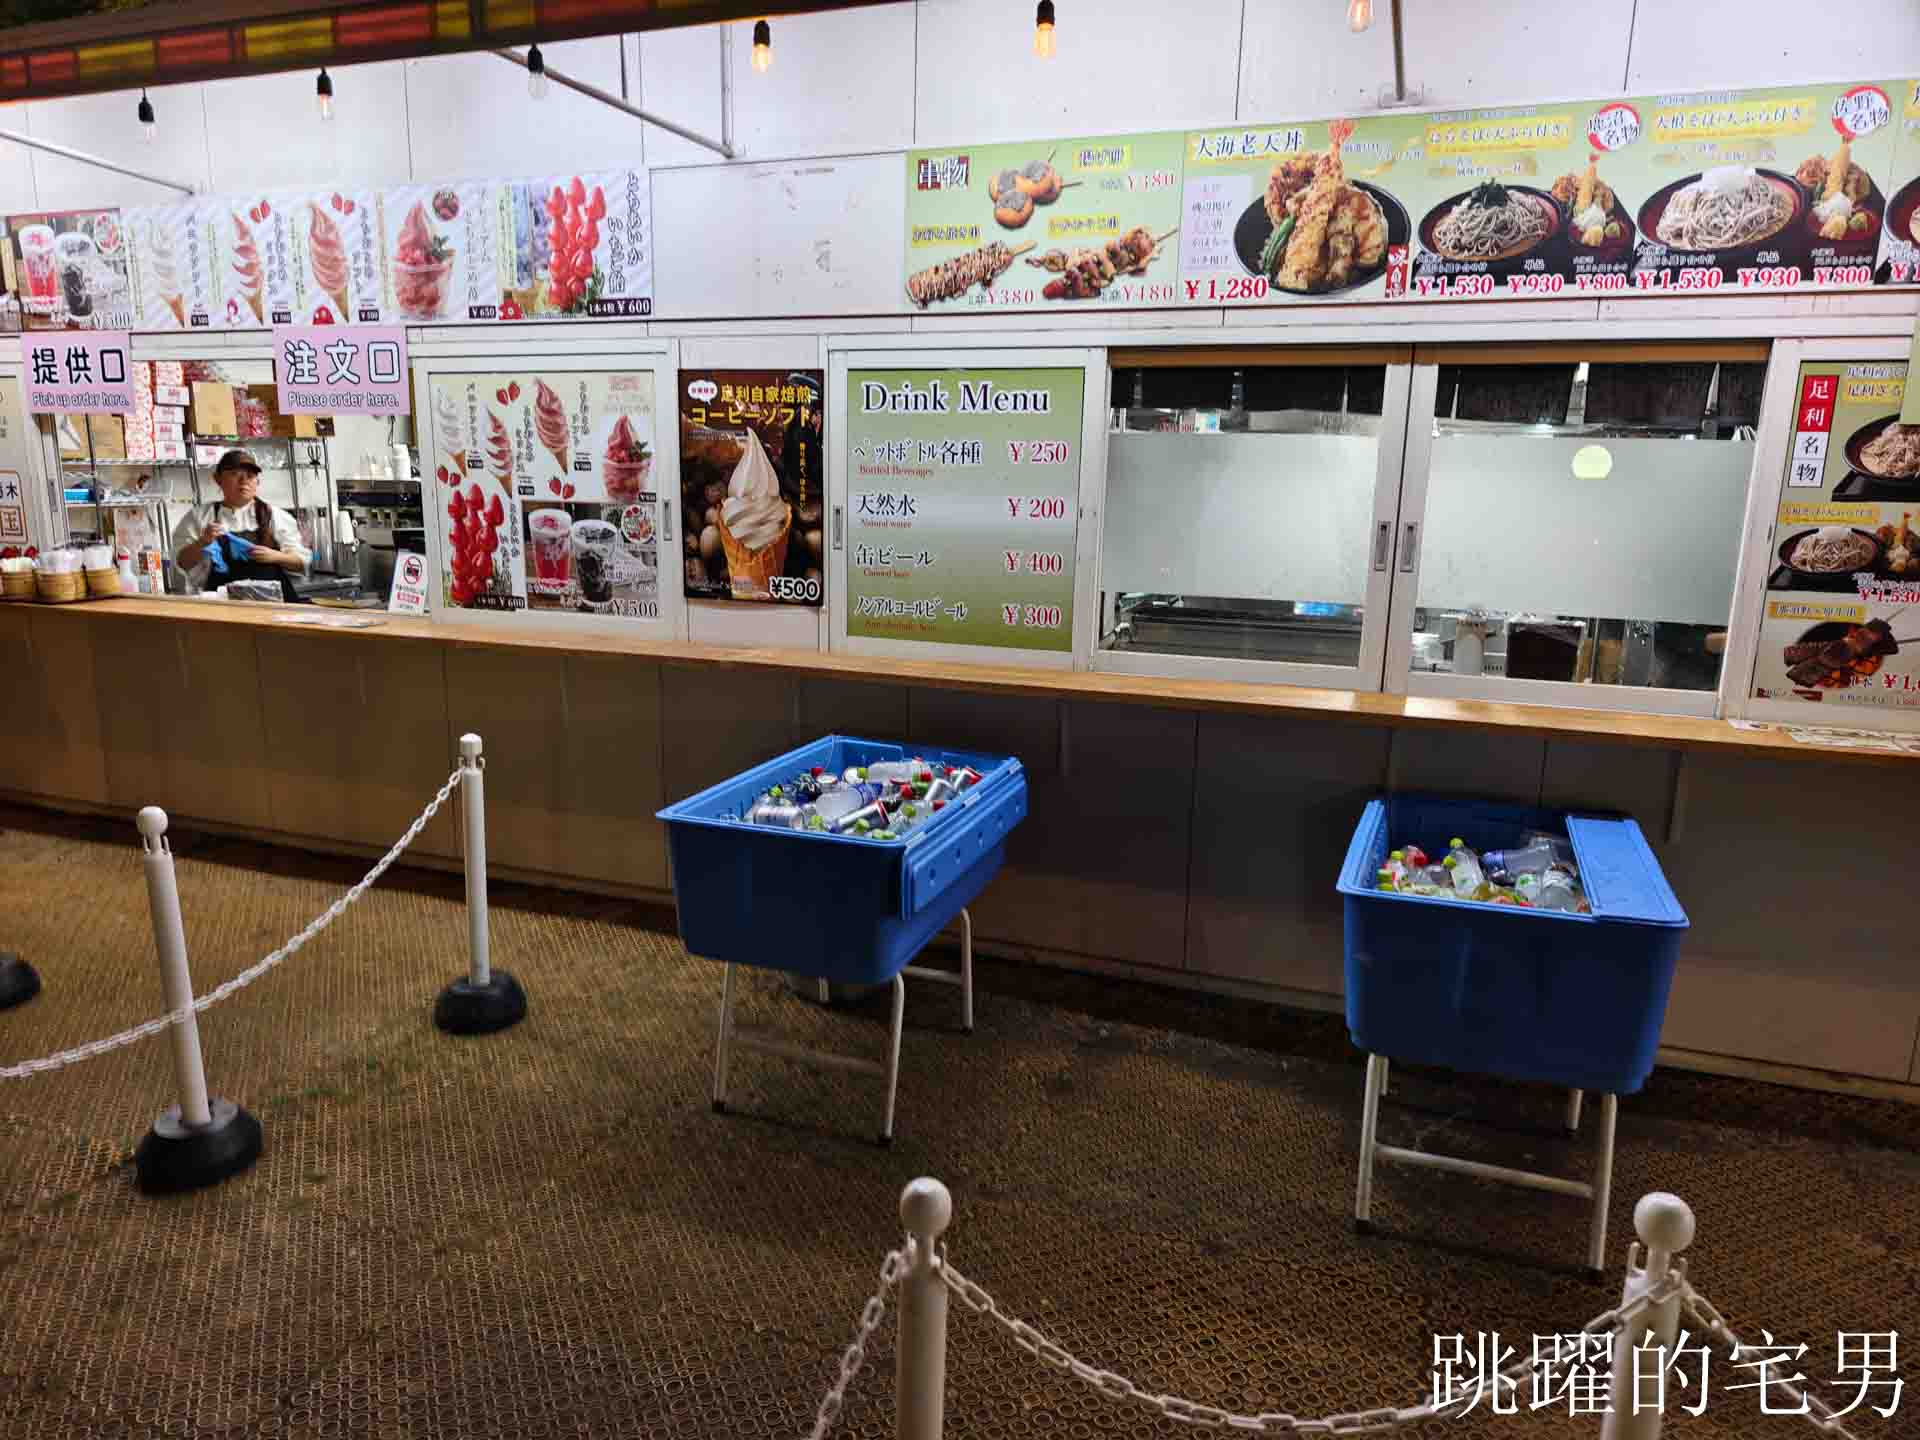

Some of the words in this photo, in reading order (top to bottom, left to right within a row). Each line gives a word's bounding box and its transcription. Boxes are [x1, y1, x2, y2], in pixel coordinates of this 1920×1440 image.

[1198, 131, 1303, 158] 大海老天丼
[918, 157, 970, 190] 串物
[31, 346, 126, 385] 提供口
[284, 338, 400, 385] 注文口
[32, 391, 56, 406] Pick
[57, 395, 69, 408] up
[71, 393, 101, 407] order
[288, 391, 327, 408] Please
[329, 391, 364, 408] order
[720, 384, 812, 405] 足利自家焙煎
[863, 381, 948, 412] Drink
[960, 382, 1049, 412] Menu
[691, 405, 811, 428] コーヒーソフト
[856, 491, 917, 517] 天然水
[855, 542, 936, 567] 缶ビール
[771, 578, 819, 599] ¥500
[854, 594, 968, 621] ノンアルコールビール
